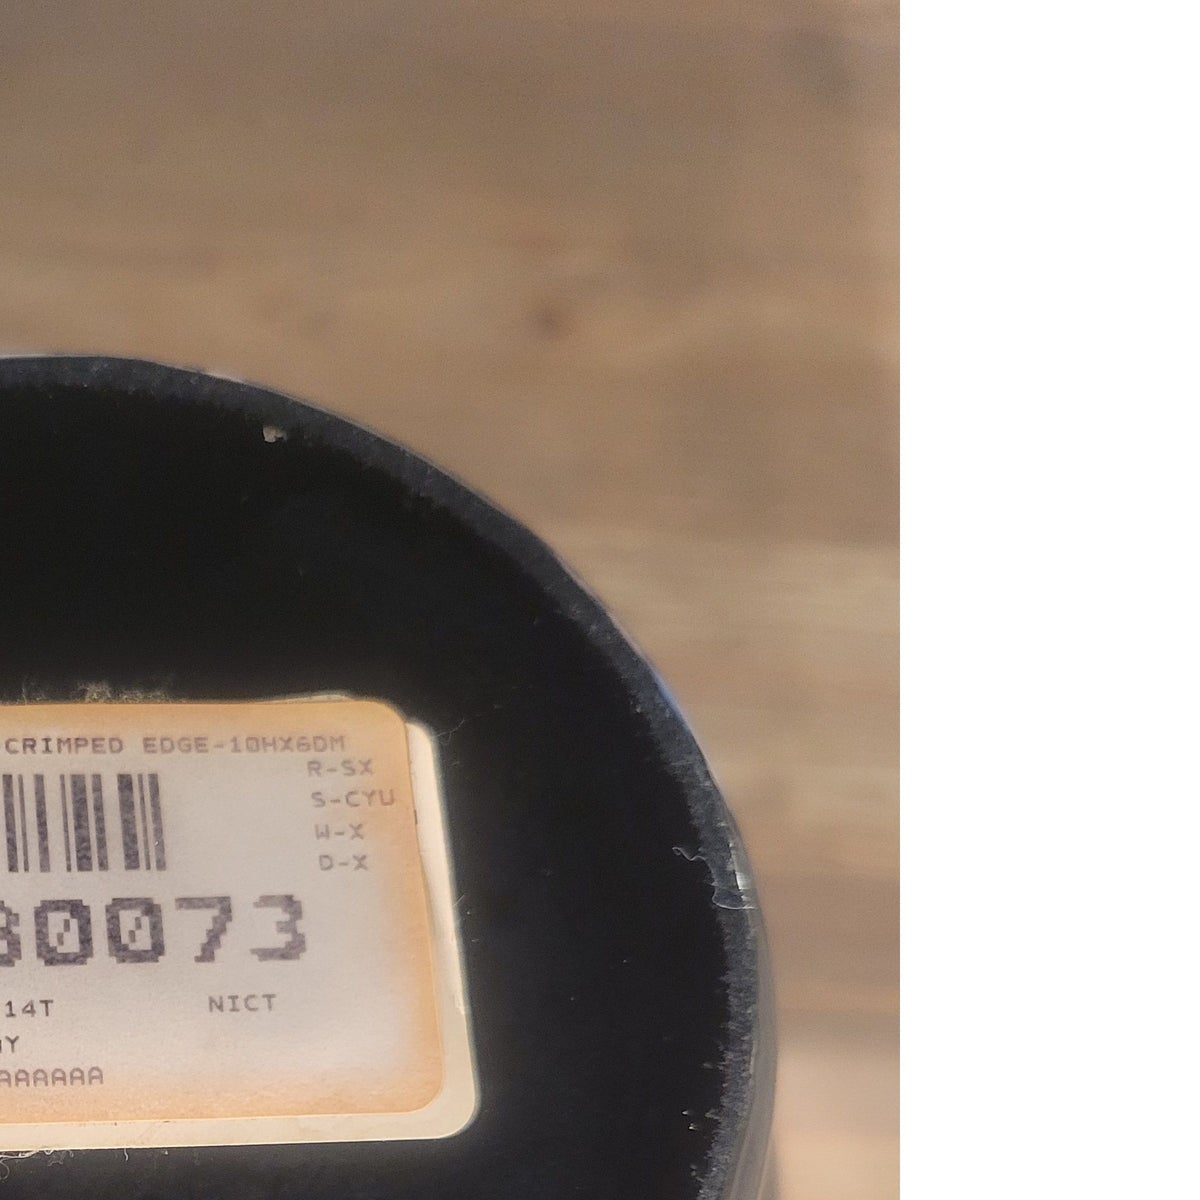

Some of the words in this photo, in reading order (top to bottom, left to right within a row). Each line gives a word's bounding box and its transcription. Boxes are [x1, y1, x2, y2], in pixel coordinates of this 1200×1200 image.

[306, 758, 374, 778] R-SX
[311, 788, 395, 808] S-CYU
[318, 853, 369, 871] D-X
[5, 999, 53, 1018] 14T
[208, 994, 277, 1013] NICT
